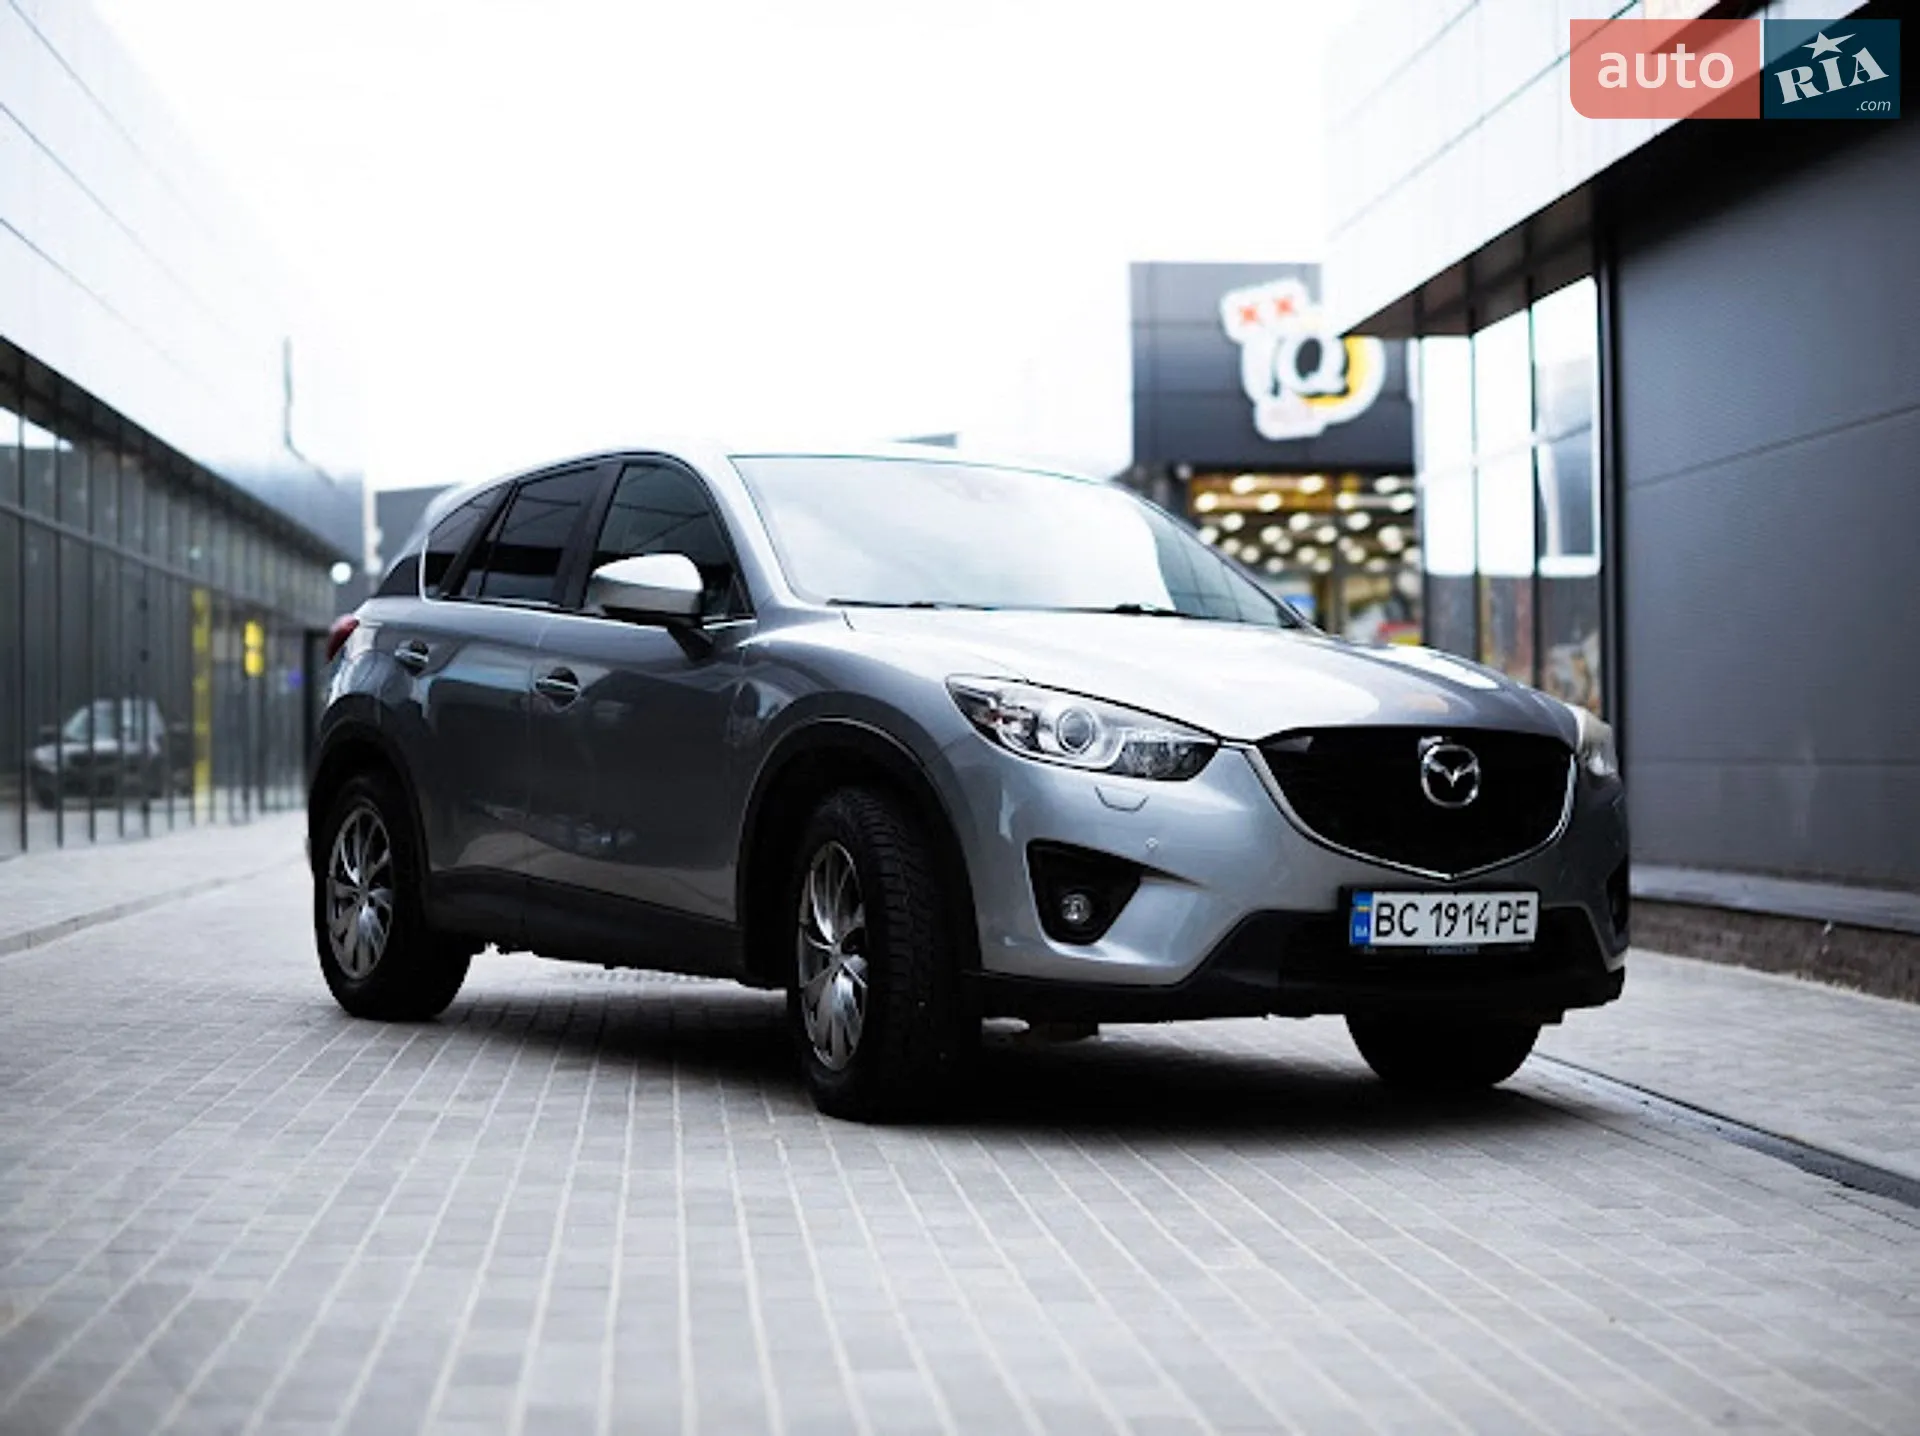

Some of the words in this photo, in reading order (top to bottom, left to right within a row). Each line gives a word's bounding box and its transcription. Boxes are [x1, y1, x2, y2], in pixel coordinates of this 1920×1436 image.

[1375, 902, 1420, 938] BC
[1430, 901, 1490, 938] 1914
[1495, 900, 1530, 935] PE
